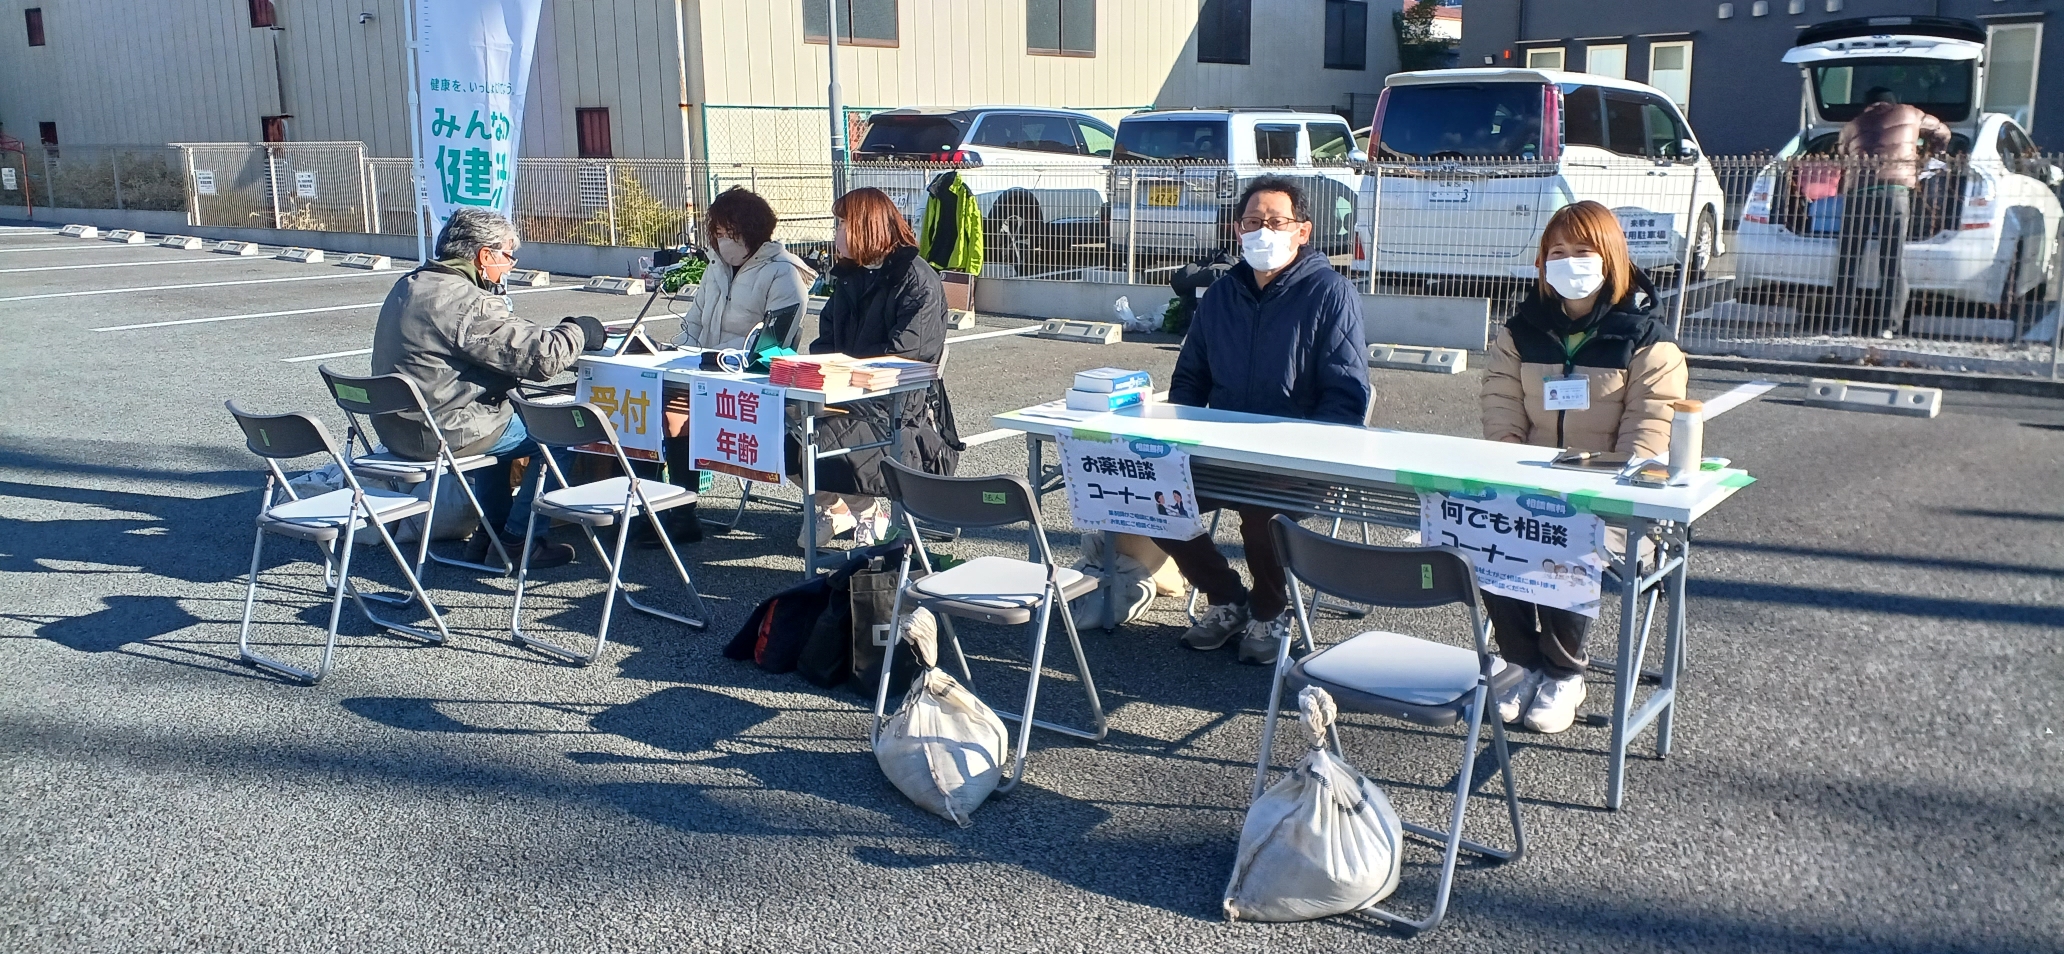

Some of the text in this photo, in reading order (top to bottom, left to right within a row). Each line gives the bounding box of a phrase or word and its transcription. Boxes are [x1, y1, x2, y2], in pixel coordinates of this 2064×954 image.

[589, 386, 650, 435] 受付
[715, 387, 760, 425] 血管
[716, 427, 759, 466] 年齢
[1081, 455, 1157, 482] お薬相談
[1087, 482, 1151, 505] コーナー
[1440, 499, 1568, 549] 何でも相談
[1441, 529, 1529, 564] コーナー
